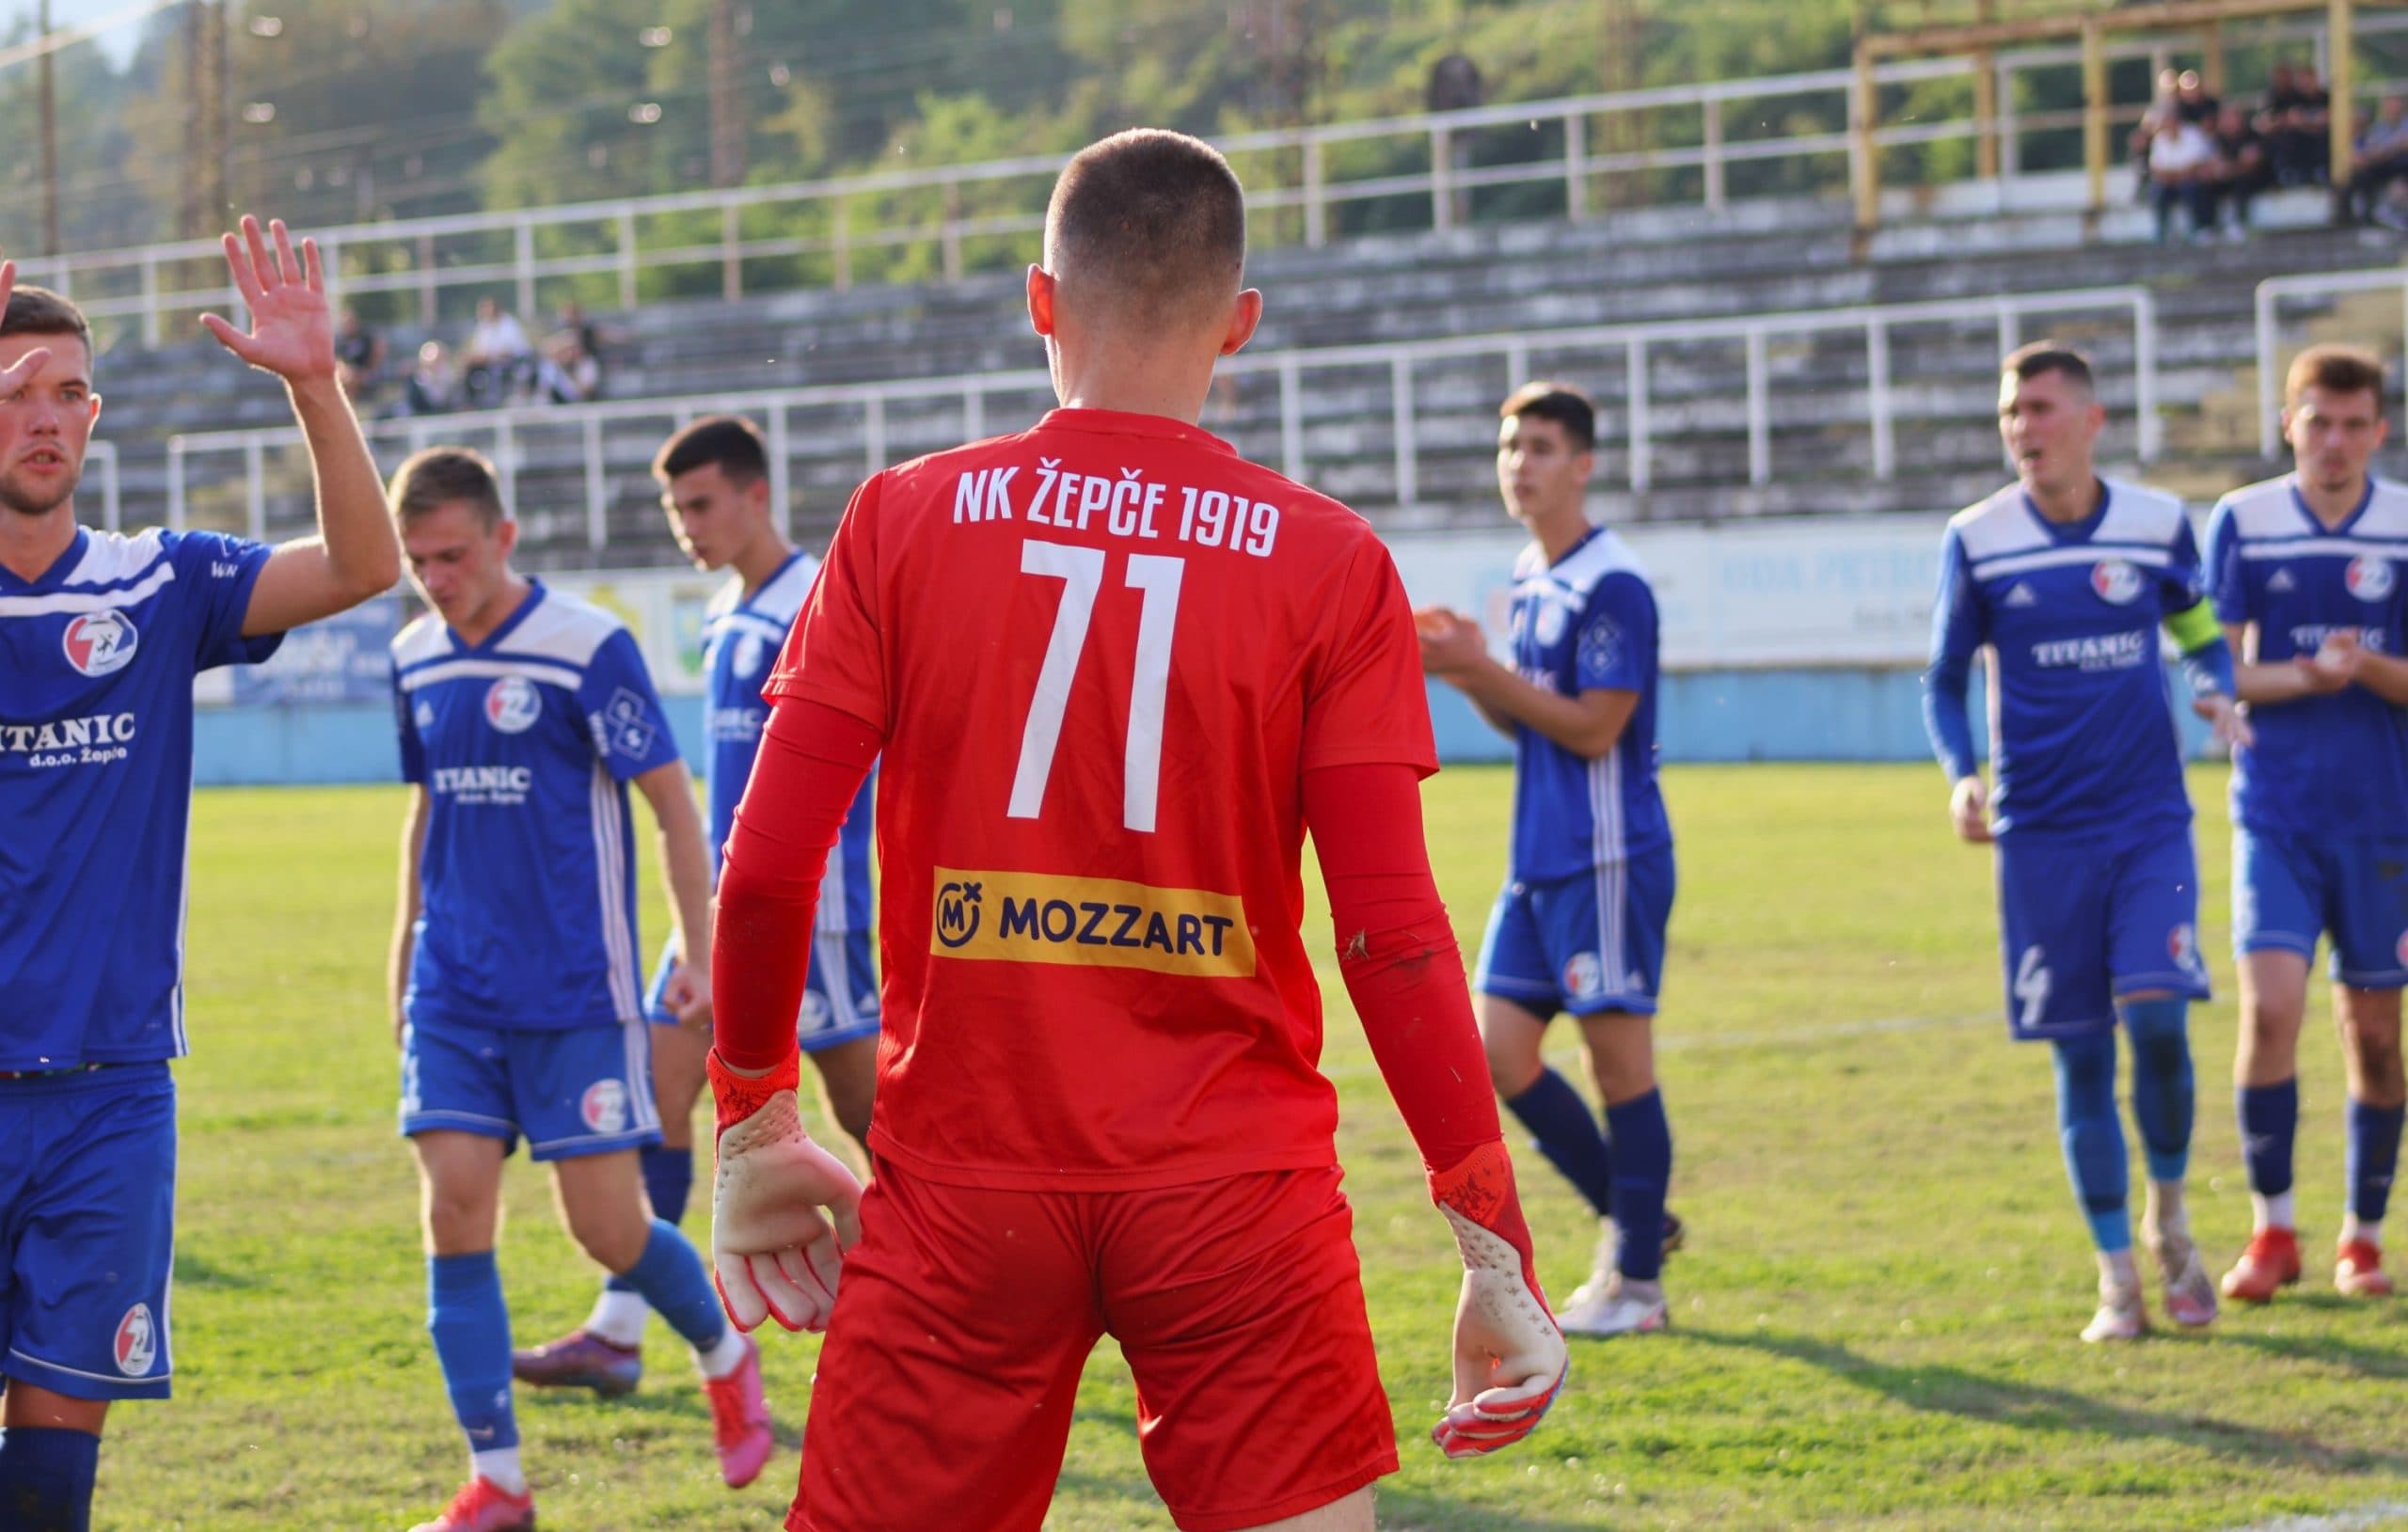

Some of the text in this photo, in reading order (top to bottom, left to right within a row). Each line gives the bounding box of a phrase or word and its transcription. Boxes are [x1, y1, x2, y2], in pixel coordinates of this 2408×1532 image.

[953, 456, 1280, 558] NK ŽEPČE 1919
[1006, 538, 1186, 833] 71
[999, 896, 1234, 957] MOZZART
[2015, 944, 2052, 1031] 4
